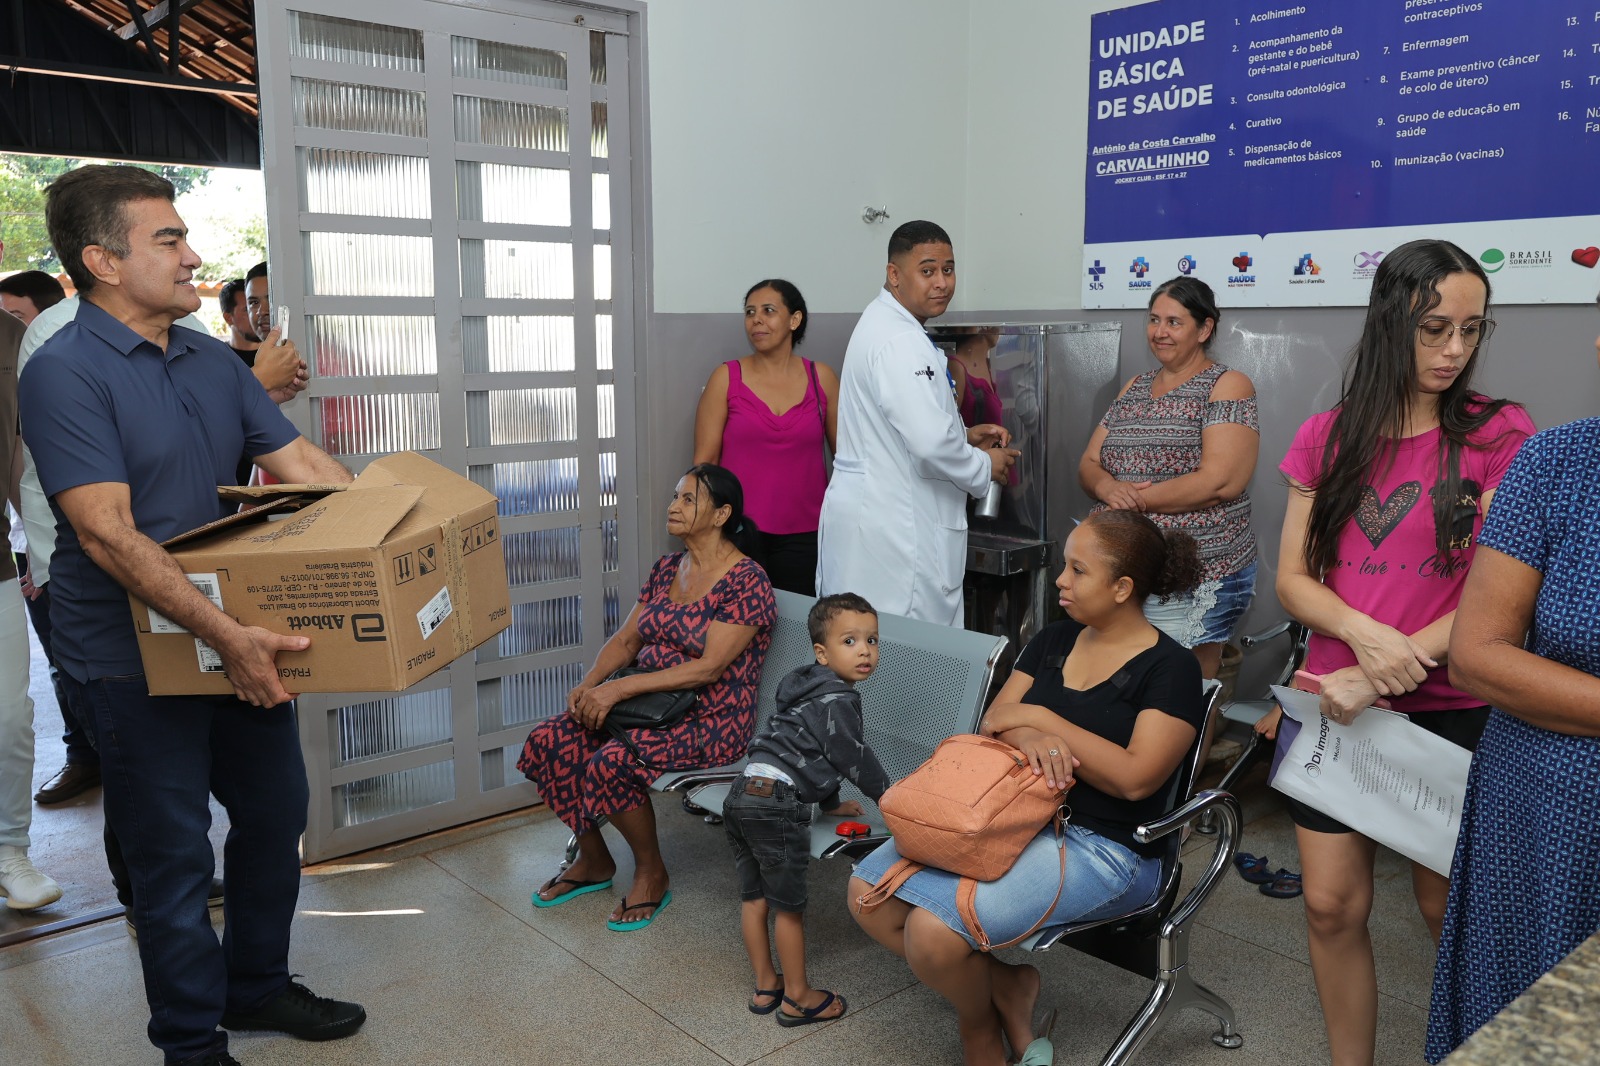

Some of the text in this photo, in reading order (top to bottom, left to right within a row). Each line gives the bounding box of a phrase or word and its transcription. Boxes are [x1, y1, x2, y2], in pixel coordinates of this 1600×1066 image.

[1250, 6, 1305, 23] Acolhimento
[1404, 2, 1482, 22] contraceptivos
[1566, 17, 1580, 26] 13.
[1099, 20, 1205, 58] UNIDADE
[1249, 27, 1329, 50] Acompanhamento
[1332, 26, 1342, 34] da
[1403, 34, 1469, 52] Enfermagem
[1249, 50, 1286, 64] gestante
[1296, 46, 1308, 54] do
[1310, 41, 1333, 52] bebê
[1563, 48, 1576, 58] 14.
[1248, 61, 1291, 77] (pré-natal
[1301, 50, 1360, 70] puericultura)
[1401, 68, 1435, 81] Exame
[1438, 60, 1495, 76] preventivo
[1498, 53, 1540, 69] (câncer
[1098, 57, 1184, 89] BÁSICA
[1247, 89, 1284, 102] Consulta
[1286, 80, 1346, 98] odontológica
[1399, 75, 1489, 95] de colo de útero)
[1560, 80, 1574, 89] 15.
[1097, 84, 1213, 119] DE SAÚDE
[1246, 117, 1282, 128] Curativo
[1377, 102, 1520, 126] 9. Grupo de educação em
[1558, 112, 1571, 120] 16.
[1396, 126, 1427, 138] saúde
[1093, 133, 1216, 154] Antônio da Costa Carvalho
[1245, 140, 1299, 155] Dispensação
[1301, 139, 1312, 148] de
[1096, 150, 1210, 174] CARVALHINHO
[1244, 149, 1342, 167] medicamentos básicos
[1371, 147, 1504, 168] 10. Imunização (vacinas)
[1115, 176, 1136, 184] JOCKEY
[1510, 250, 1552, 258] BRASIL
[1089, 282, 1104, 290] SUS
[1228, 274, 1256, 283] SAÚDE
[305, 561, 373, 571] Indústria Brasileira
[1359, 556, 1388, 575] love
[284, 584, 301, 592] CEP:
[284, 592, 333, 600] Bandeirantes,
[309, 601, 353, 609] Laboratórios
[355, 599, 380, 607] Abbott
[288, 614, 345, 631] Abbott
[407, 648, 436, 670] FRAGILE
[1312, 751, 1322, 764] Di
